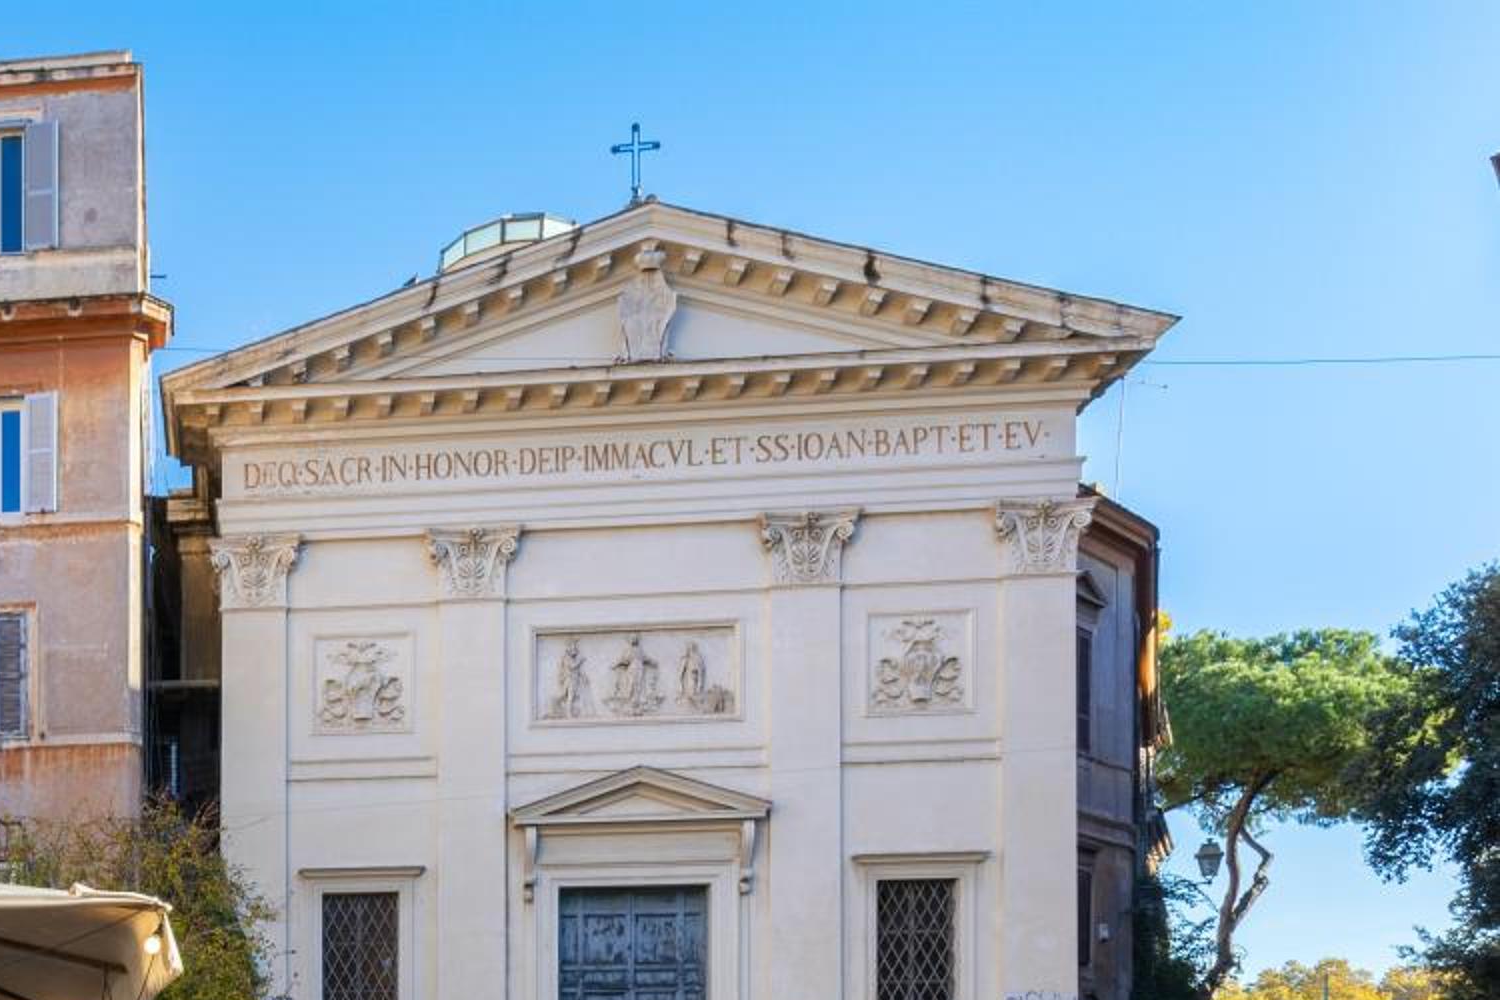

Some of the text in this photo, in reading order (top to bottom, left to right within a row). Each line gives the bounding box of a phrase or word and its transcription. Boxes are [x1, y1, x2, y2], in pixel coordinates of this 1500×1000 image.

[380, 453, 407, 483] IN
[414, 448, 510, 481] HONOR
[710, 435, 749, 465] ET
[754, 434, 790, 463] SS
[874, 424, 950, 457] BAPT
[957, 422, 997, 453] ET
